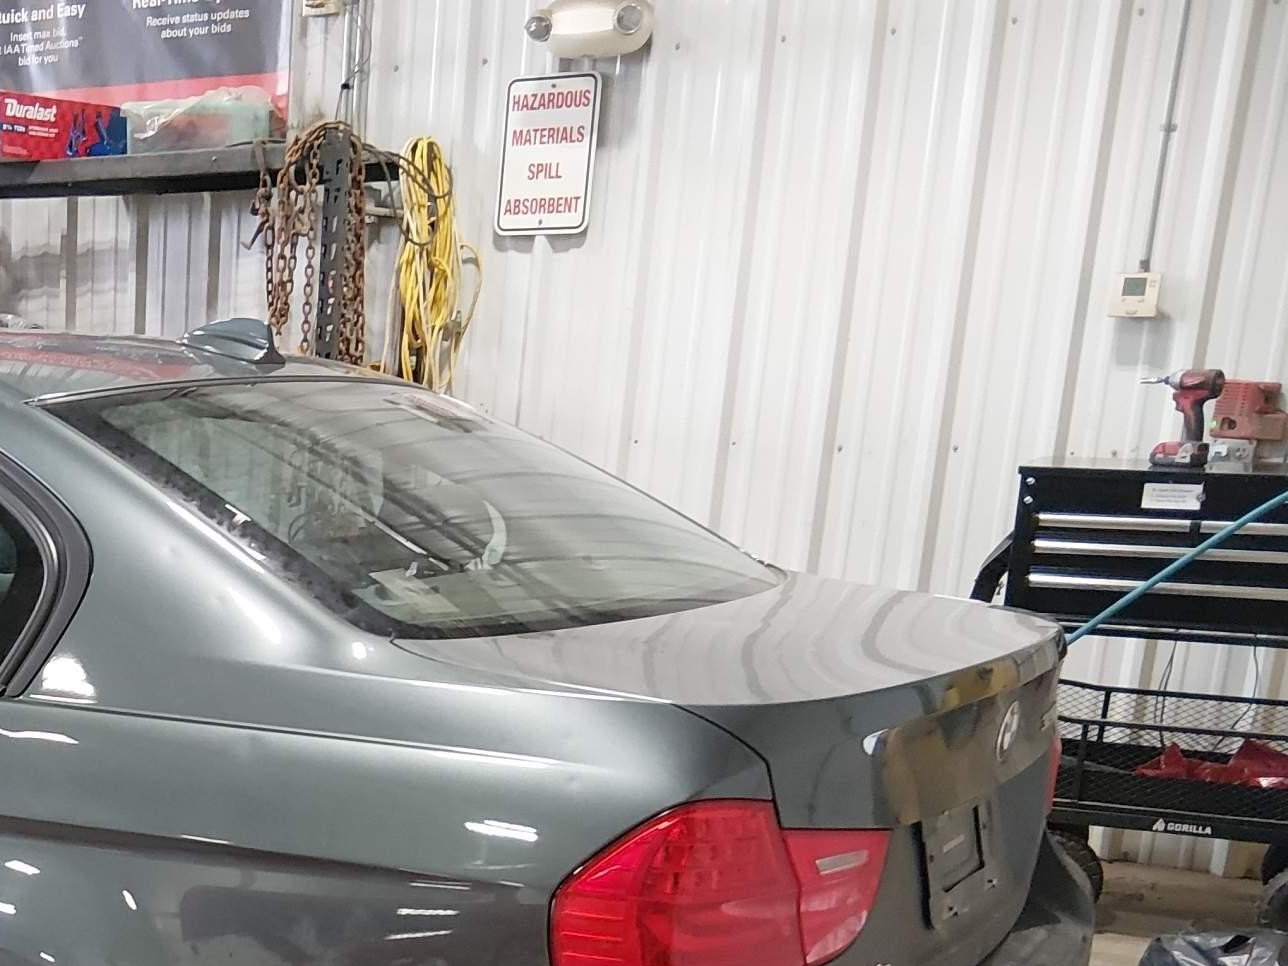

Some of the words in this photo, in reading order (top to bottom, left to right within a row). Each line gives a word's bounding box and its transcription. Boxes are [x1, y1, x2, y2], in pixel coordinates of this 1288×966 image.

[31, 5, 54, 21] and
[57, 2, 86, 20] Easy
[146, 14, 181, 27] Receive
[182, 12, 209, 24] status
[211, 9, 250, 22] updates
[161, 27, 187, 39] about
[188, 26, 210, 38] your
[212, 23, 232, 34] bids
[18, 56, 30, 66] bid
[31, 54, 43, 64] for
[44, 54, 59, 65] you
[4, 98, 57, 122] Duralast
[512, 89, 591, 112] HAZARDOUS
[511, 125, 586, 147] MATERIALS
[527, 162, 563, 181] SPILL
[504, 196, 582, 217] ABSORBENT
[1167, 822, 1212, 835] GORILLA
